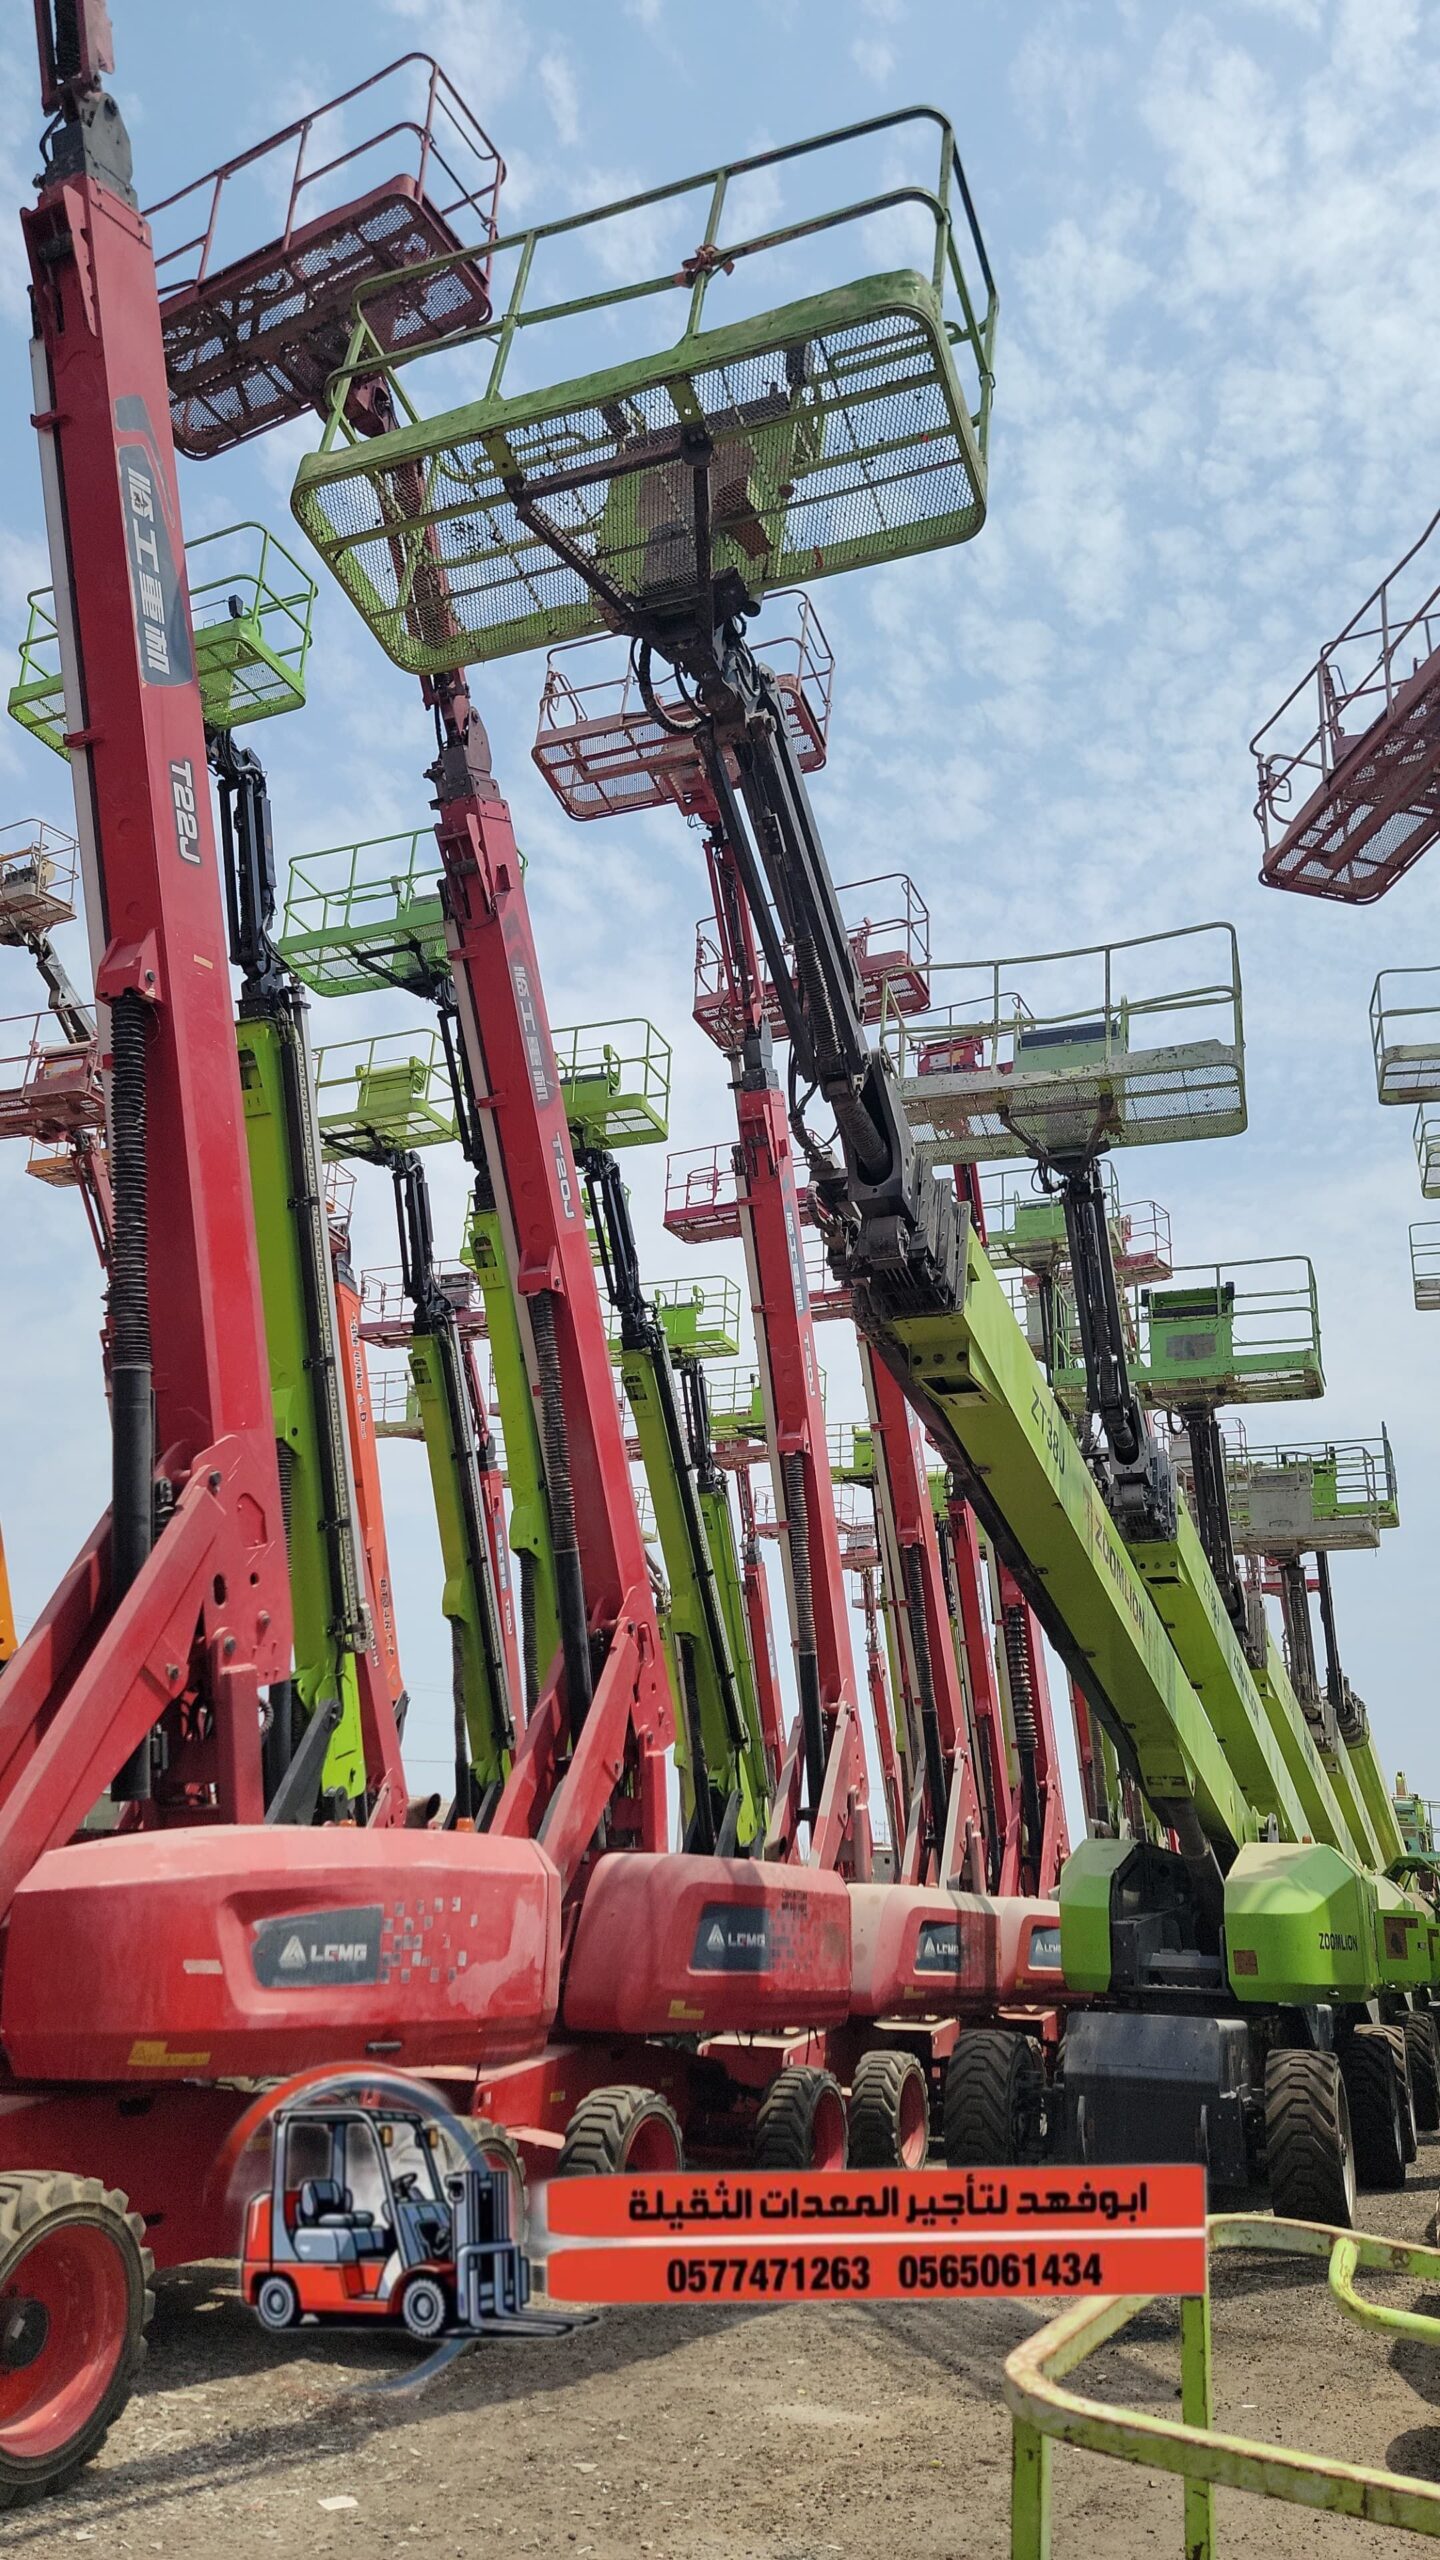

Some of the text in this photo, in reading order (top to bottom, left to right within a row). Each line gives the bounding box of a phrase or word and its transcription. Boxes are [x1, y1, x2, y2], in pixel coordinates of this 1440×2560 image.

[171, 761, 200, 864] T22J
[552, 1131, 575, 1219] T20J
[1031, 1385, 1065, 1475] ZT38J
[1095, 1516, 1145, 1631] ZOOMLION
[1318, 1933, 1358, 1951] ZOOMLION
